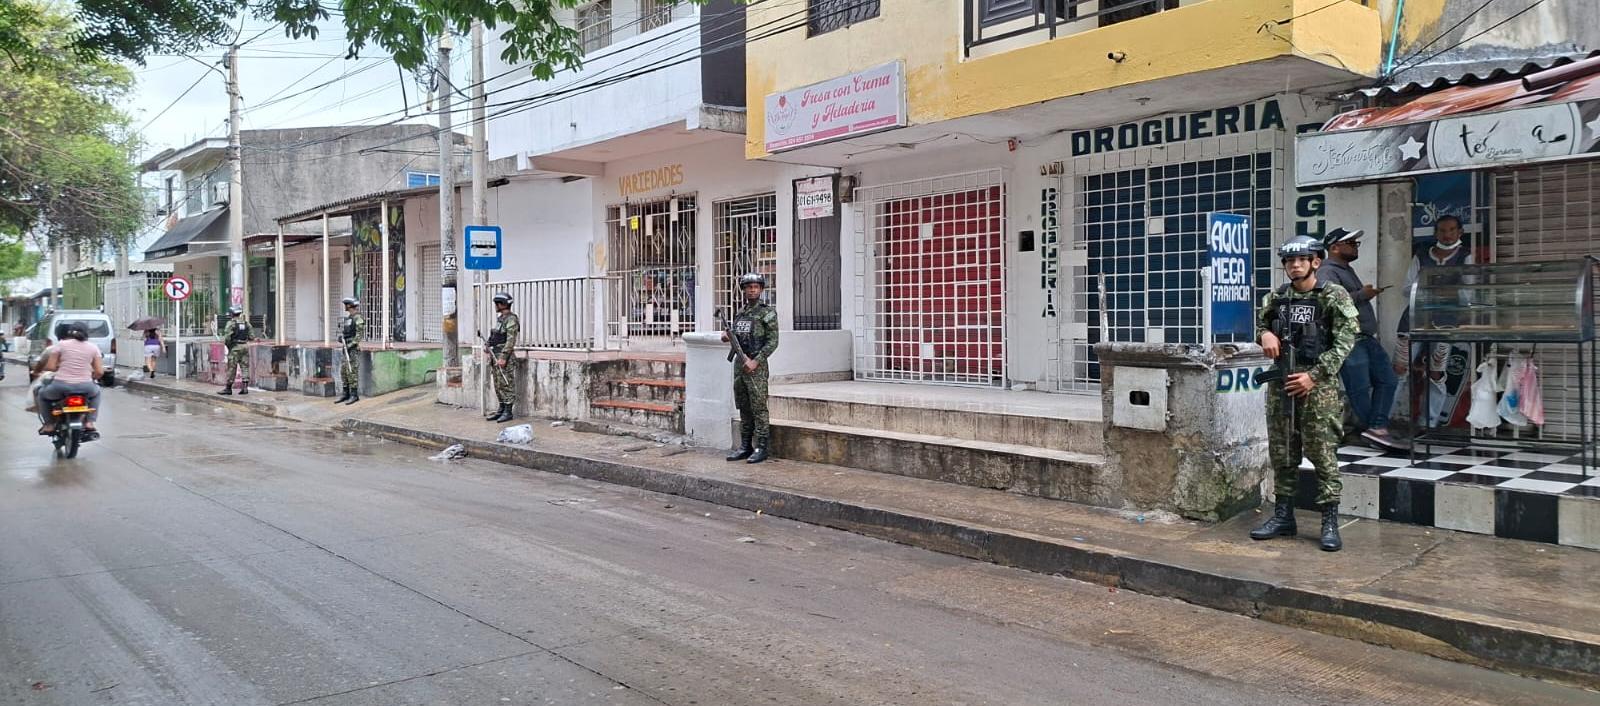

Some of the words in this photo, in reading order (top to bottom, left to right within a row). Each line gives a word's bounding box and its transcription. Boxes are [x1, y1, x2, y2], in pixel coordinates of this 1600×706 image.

[833, 86, 851, 99] con
[812, 111, 820, 129] y
[1071, 99, 1287, 157] DROGUERIA
[618, 164, 684, 196] VARIEDADES
[444, 257, 456, 267] 24
[1211, 257, 1246, 284] MEGA
[172, 280, 185, 296] P
[1212, 285, 1250, 302] FARMACIA
